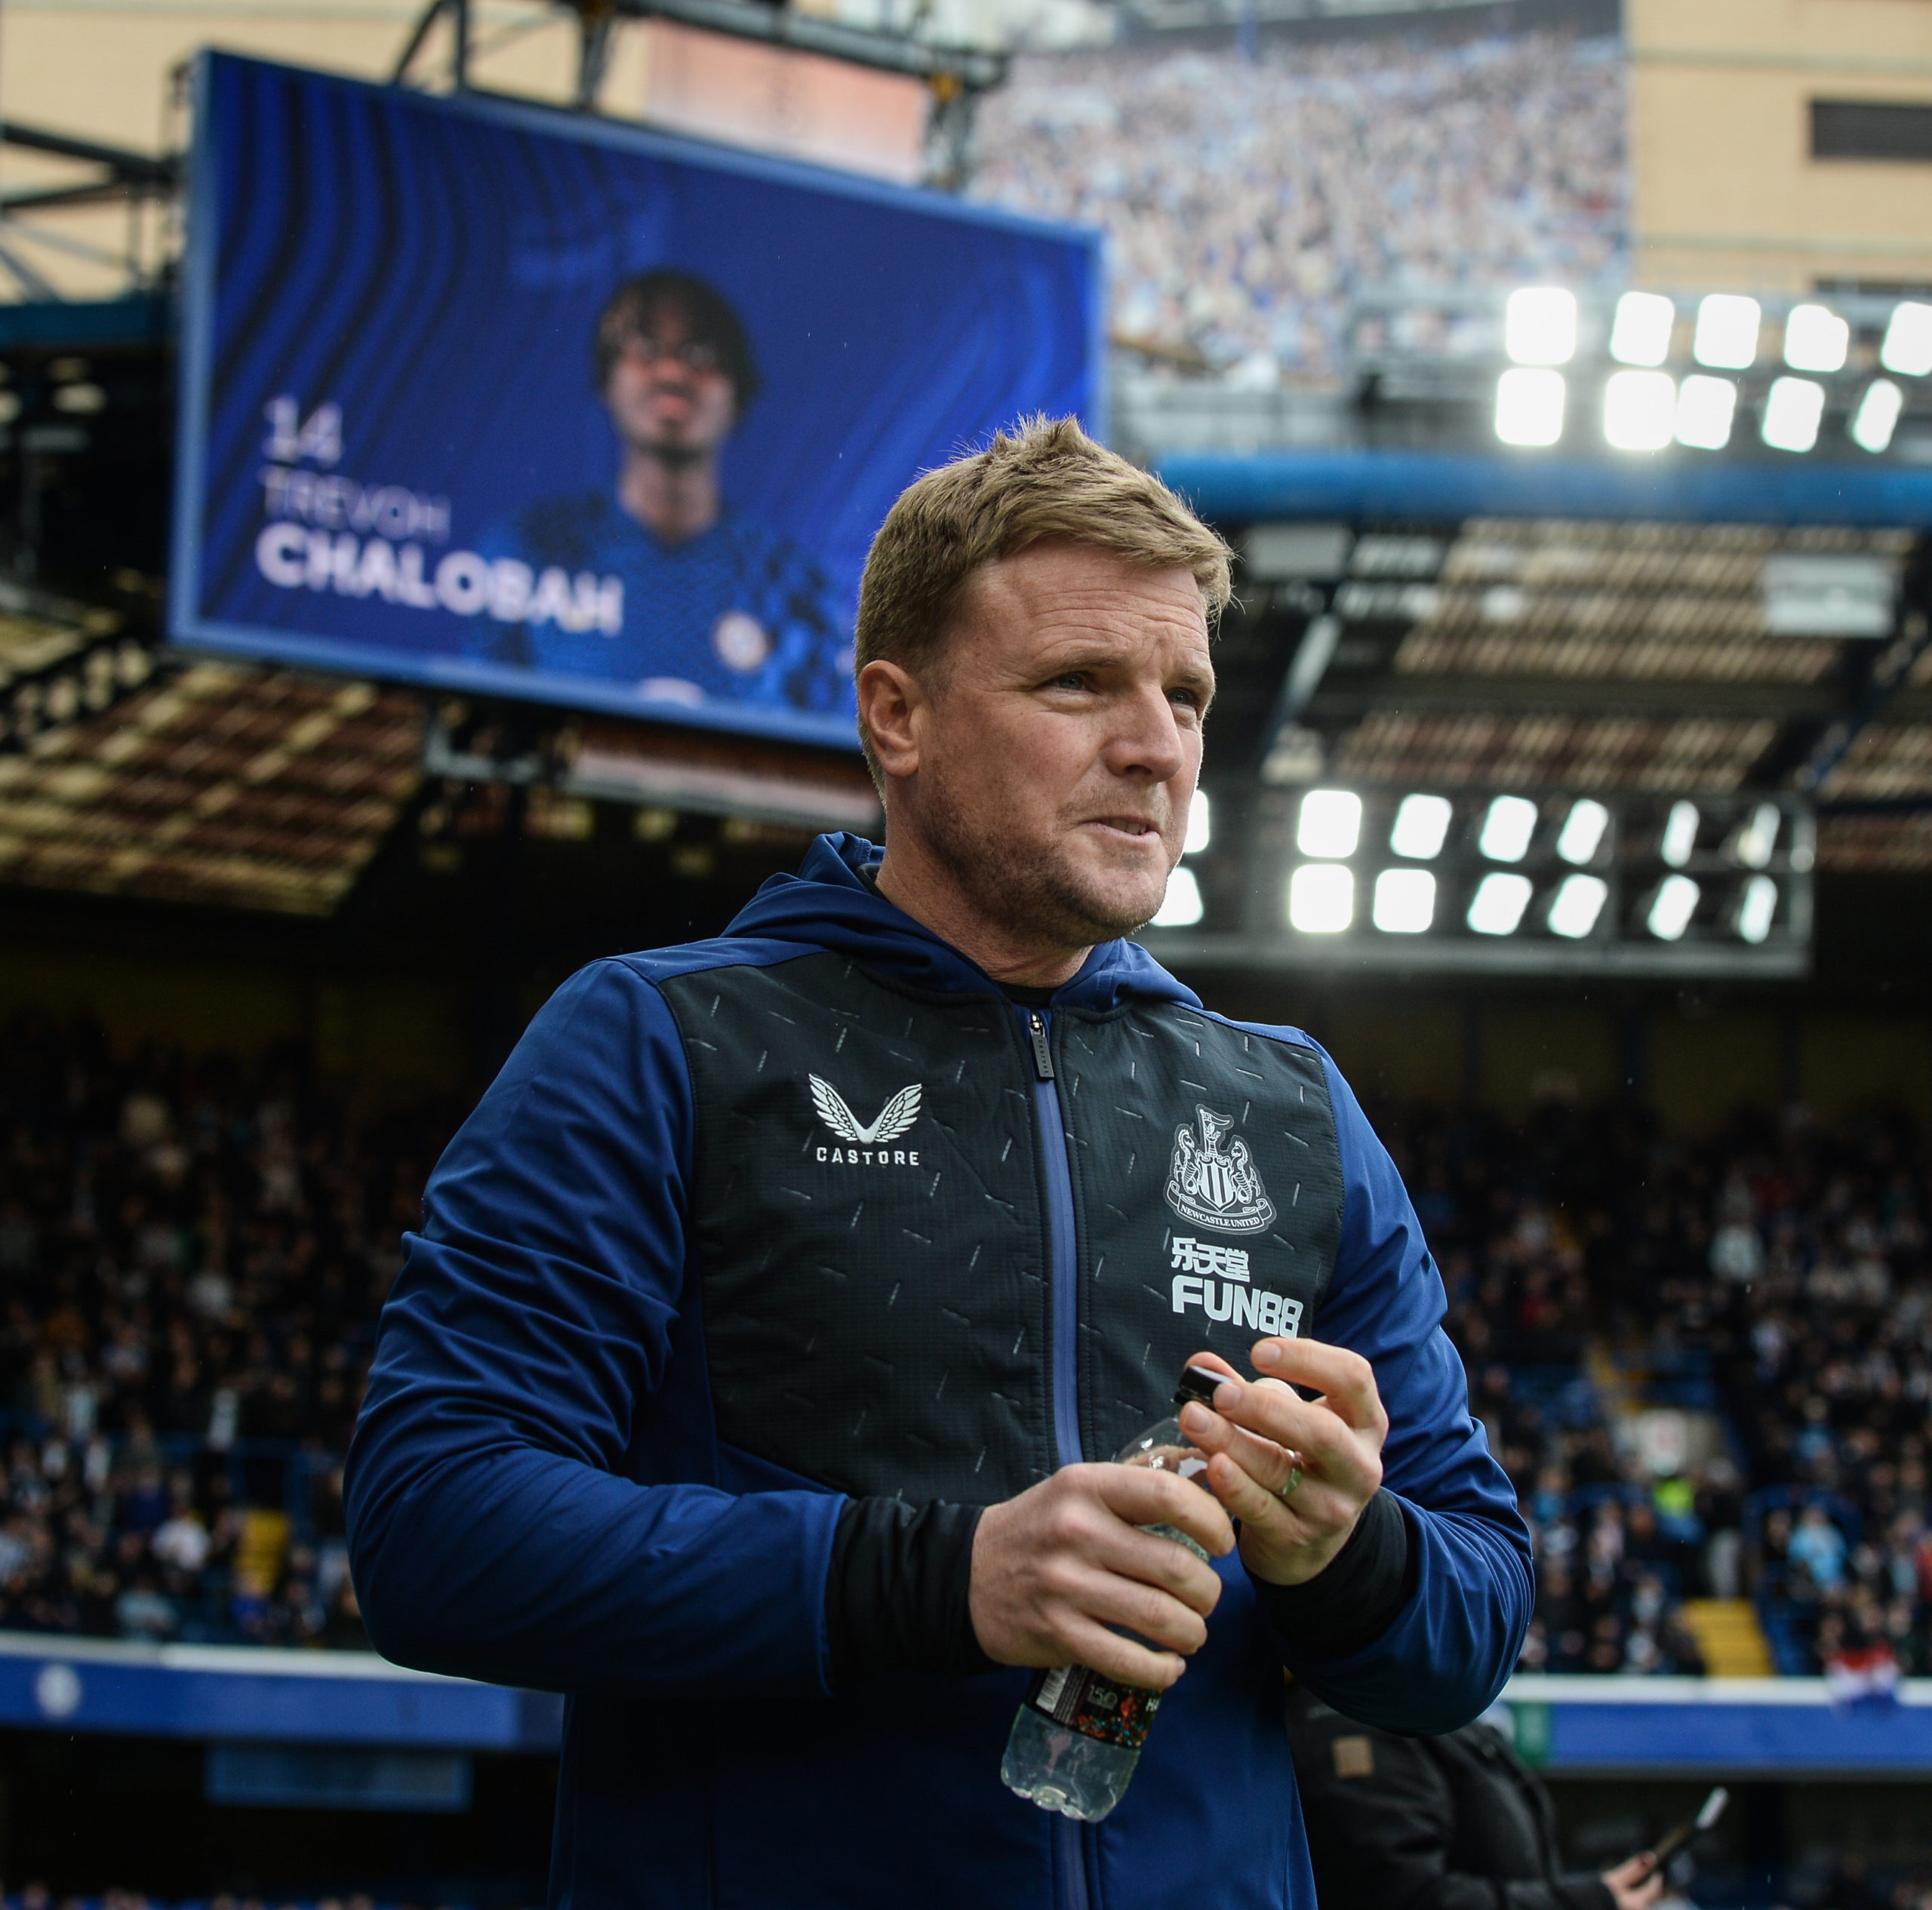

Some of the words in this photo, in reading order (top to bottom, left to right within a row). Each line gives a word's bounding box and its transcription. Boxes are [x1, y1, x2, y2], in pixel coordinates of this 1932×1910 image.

[265, 395, 343, 466] 14
[260, 466, 451, 543] TREVOH
[256, 522, 624, 637] CHALOBAH
[817, 1147, 919, 1165] CASTORE
[1181, 1206, 1231, 1227] NEWCASTLE
[1230, 1216, 1260, 1228] UNITED
[1171, 1237, 1250, 1282] 乐天堂
[1172, 1275, 1303, 1339] FUN88
